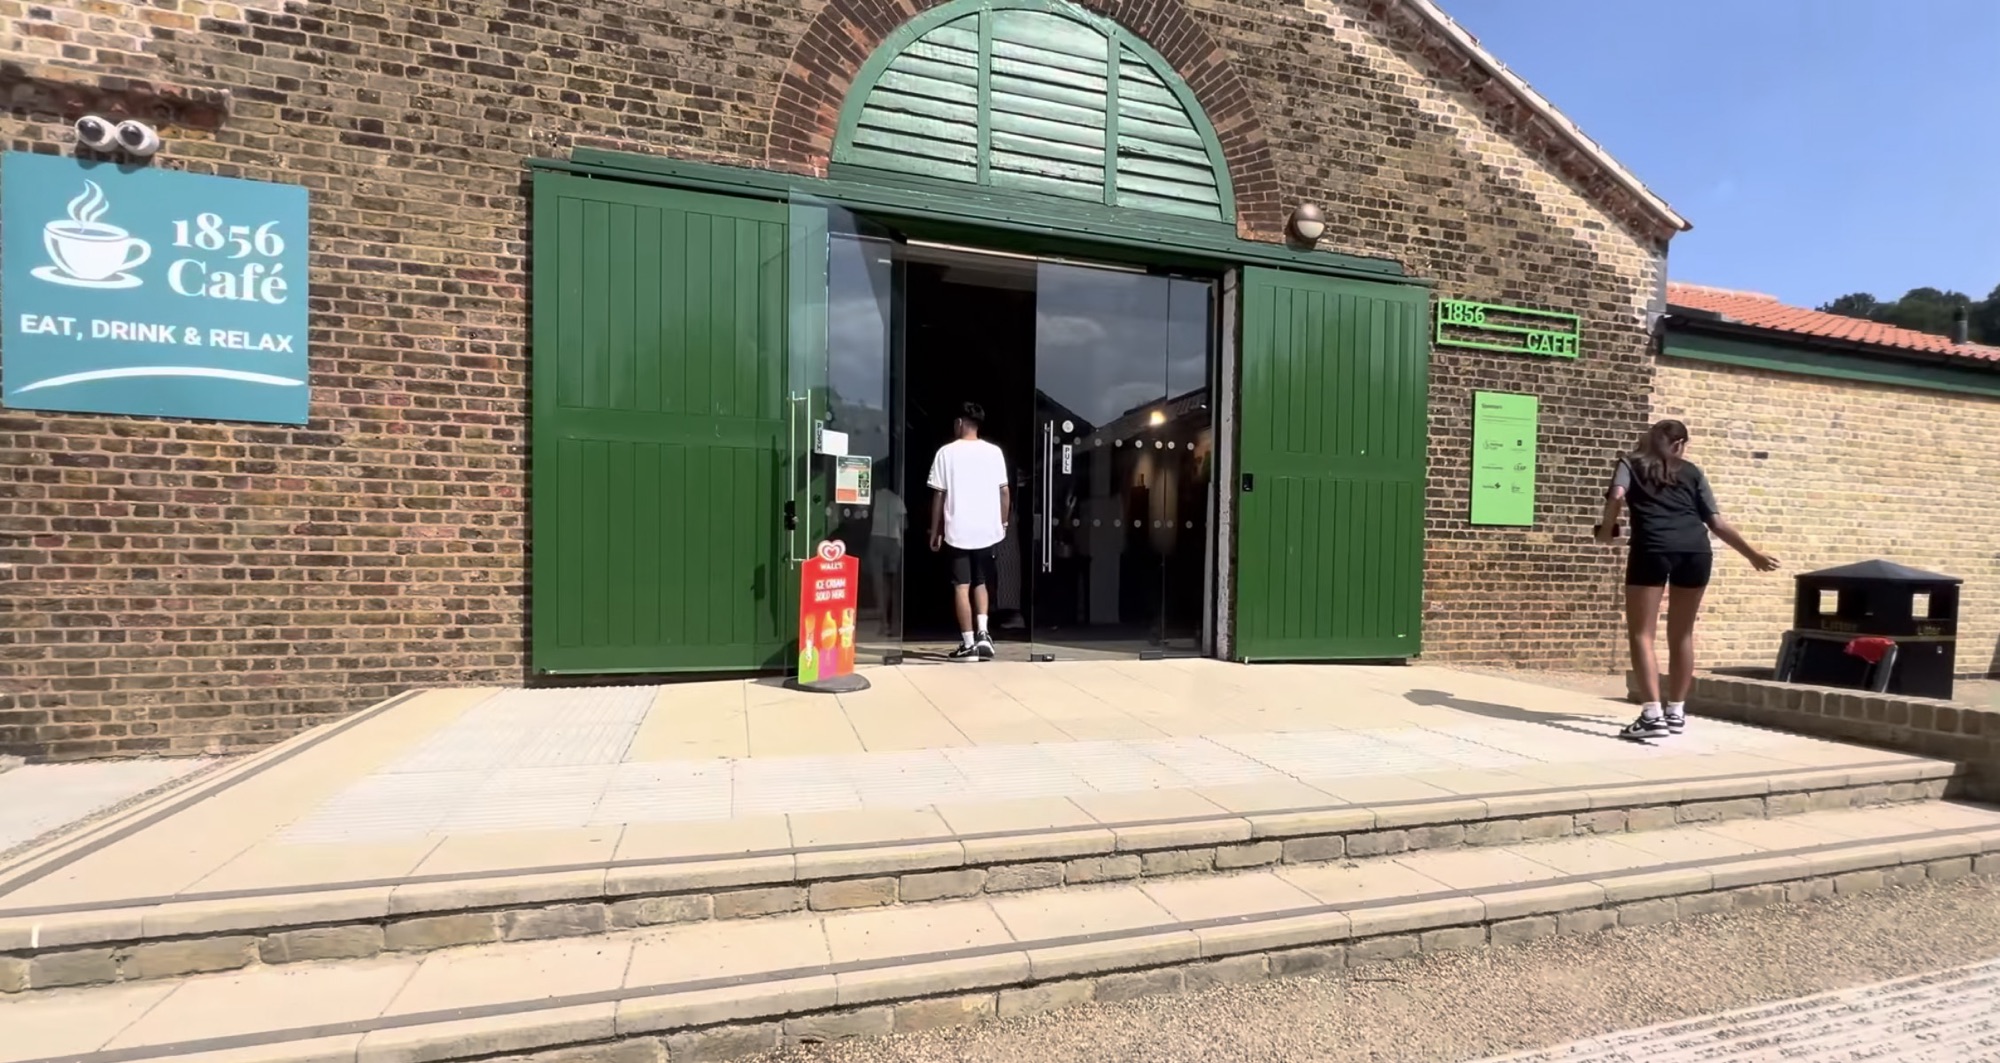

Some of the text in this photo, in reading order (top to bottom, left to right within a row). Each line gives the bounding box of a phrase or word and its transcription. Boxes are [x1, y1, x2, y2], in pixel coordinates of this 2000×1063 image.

[172, 212, 285, 259] 1856
[167, 258, 288, 304] Café
[20, 313, 294, 353] EAT, DRINK & RELAX
[1445, 302, 1485, 324] 1856
[1527, 333, 1573, 354] CAFE
